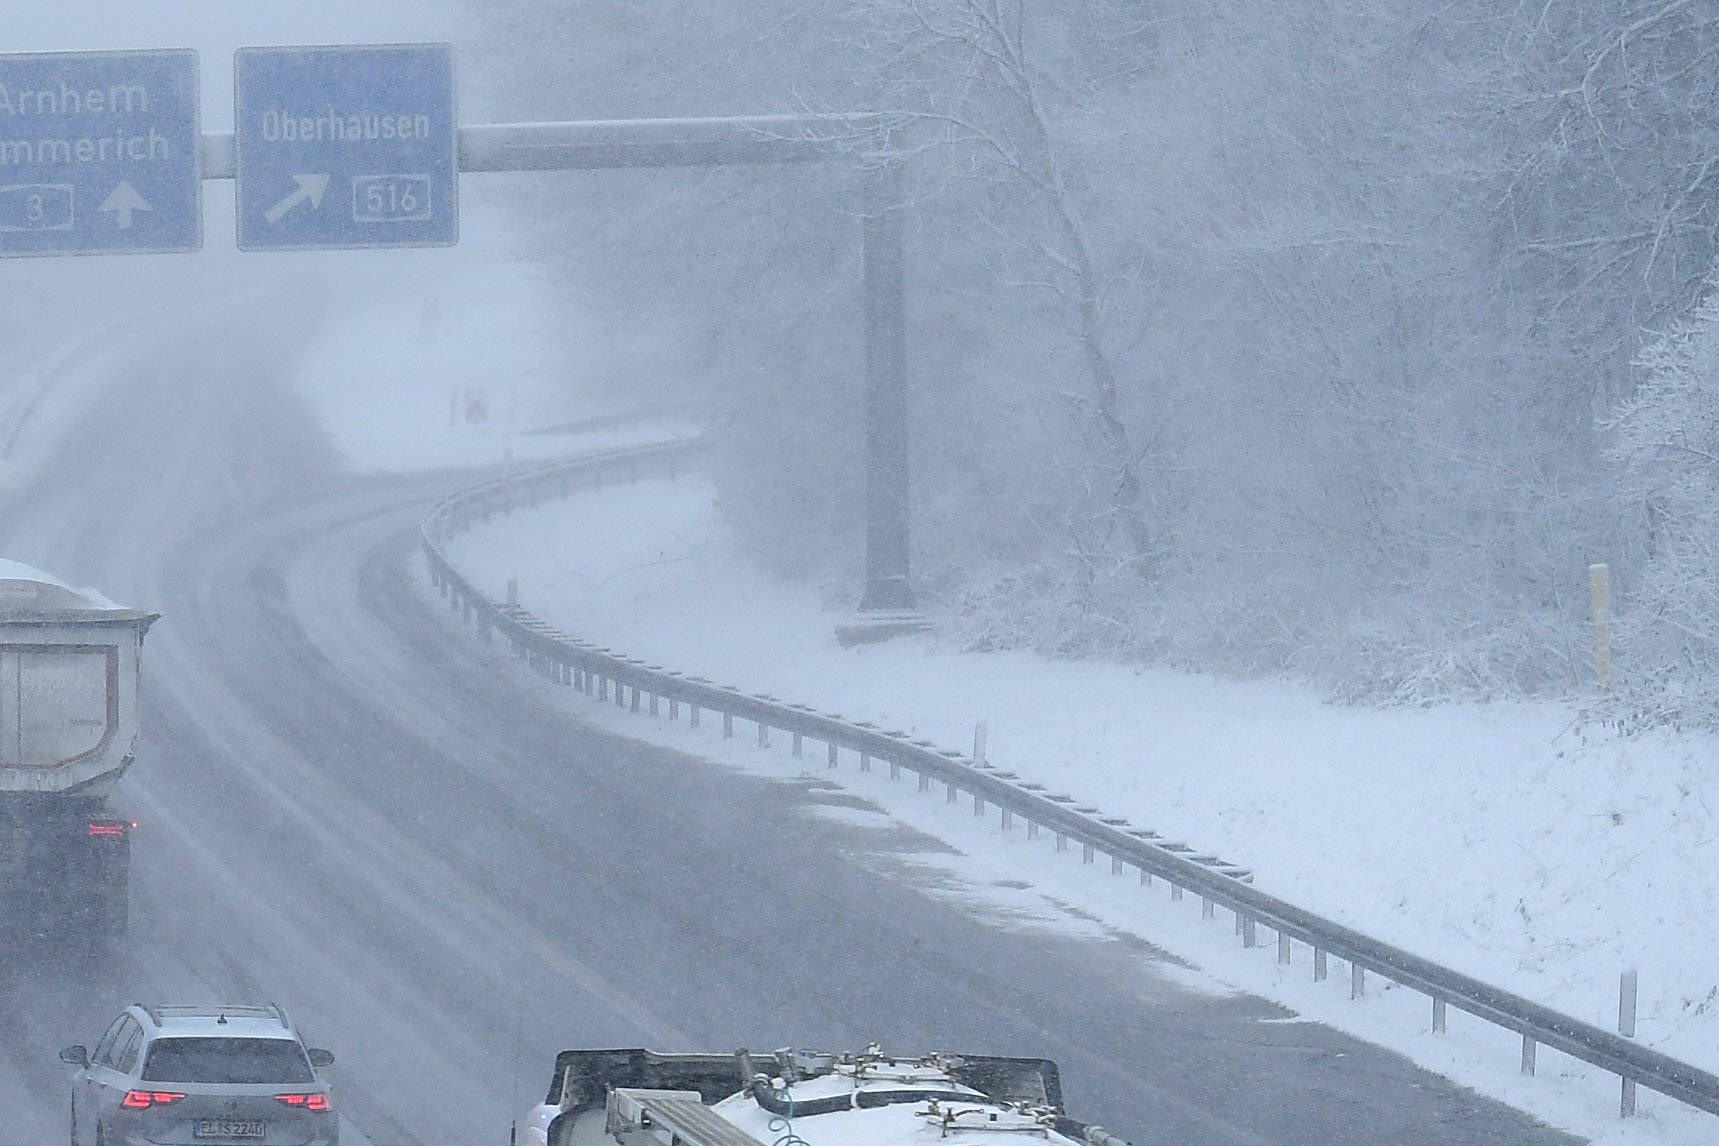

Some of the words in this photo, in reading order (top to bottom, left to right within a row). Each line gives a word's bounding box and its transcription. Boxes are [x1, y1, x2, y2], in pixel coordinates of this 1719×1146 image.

[263, 108, 429, 141] Oberhausen
[28, 194, 44, 222] 3
[367, 185, 417, 212] 516
